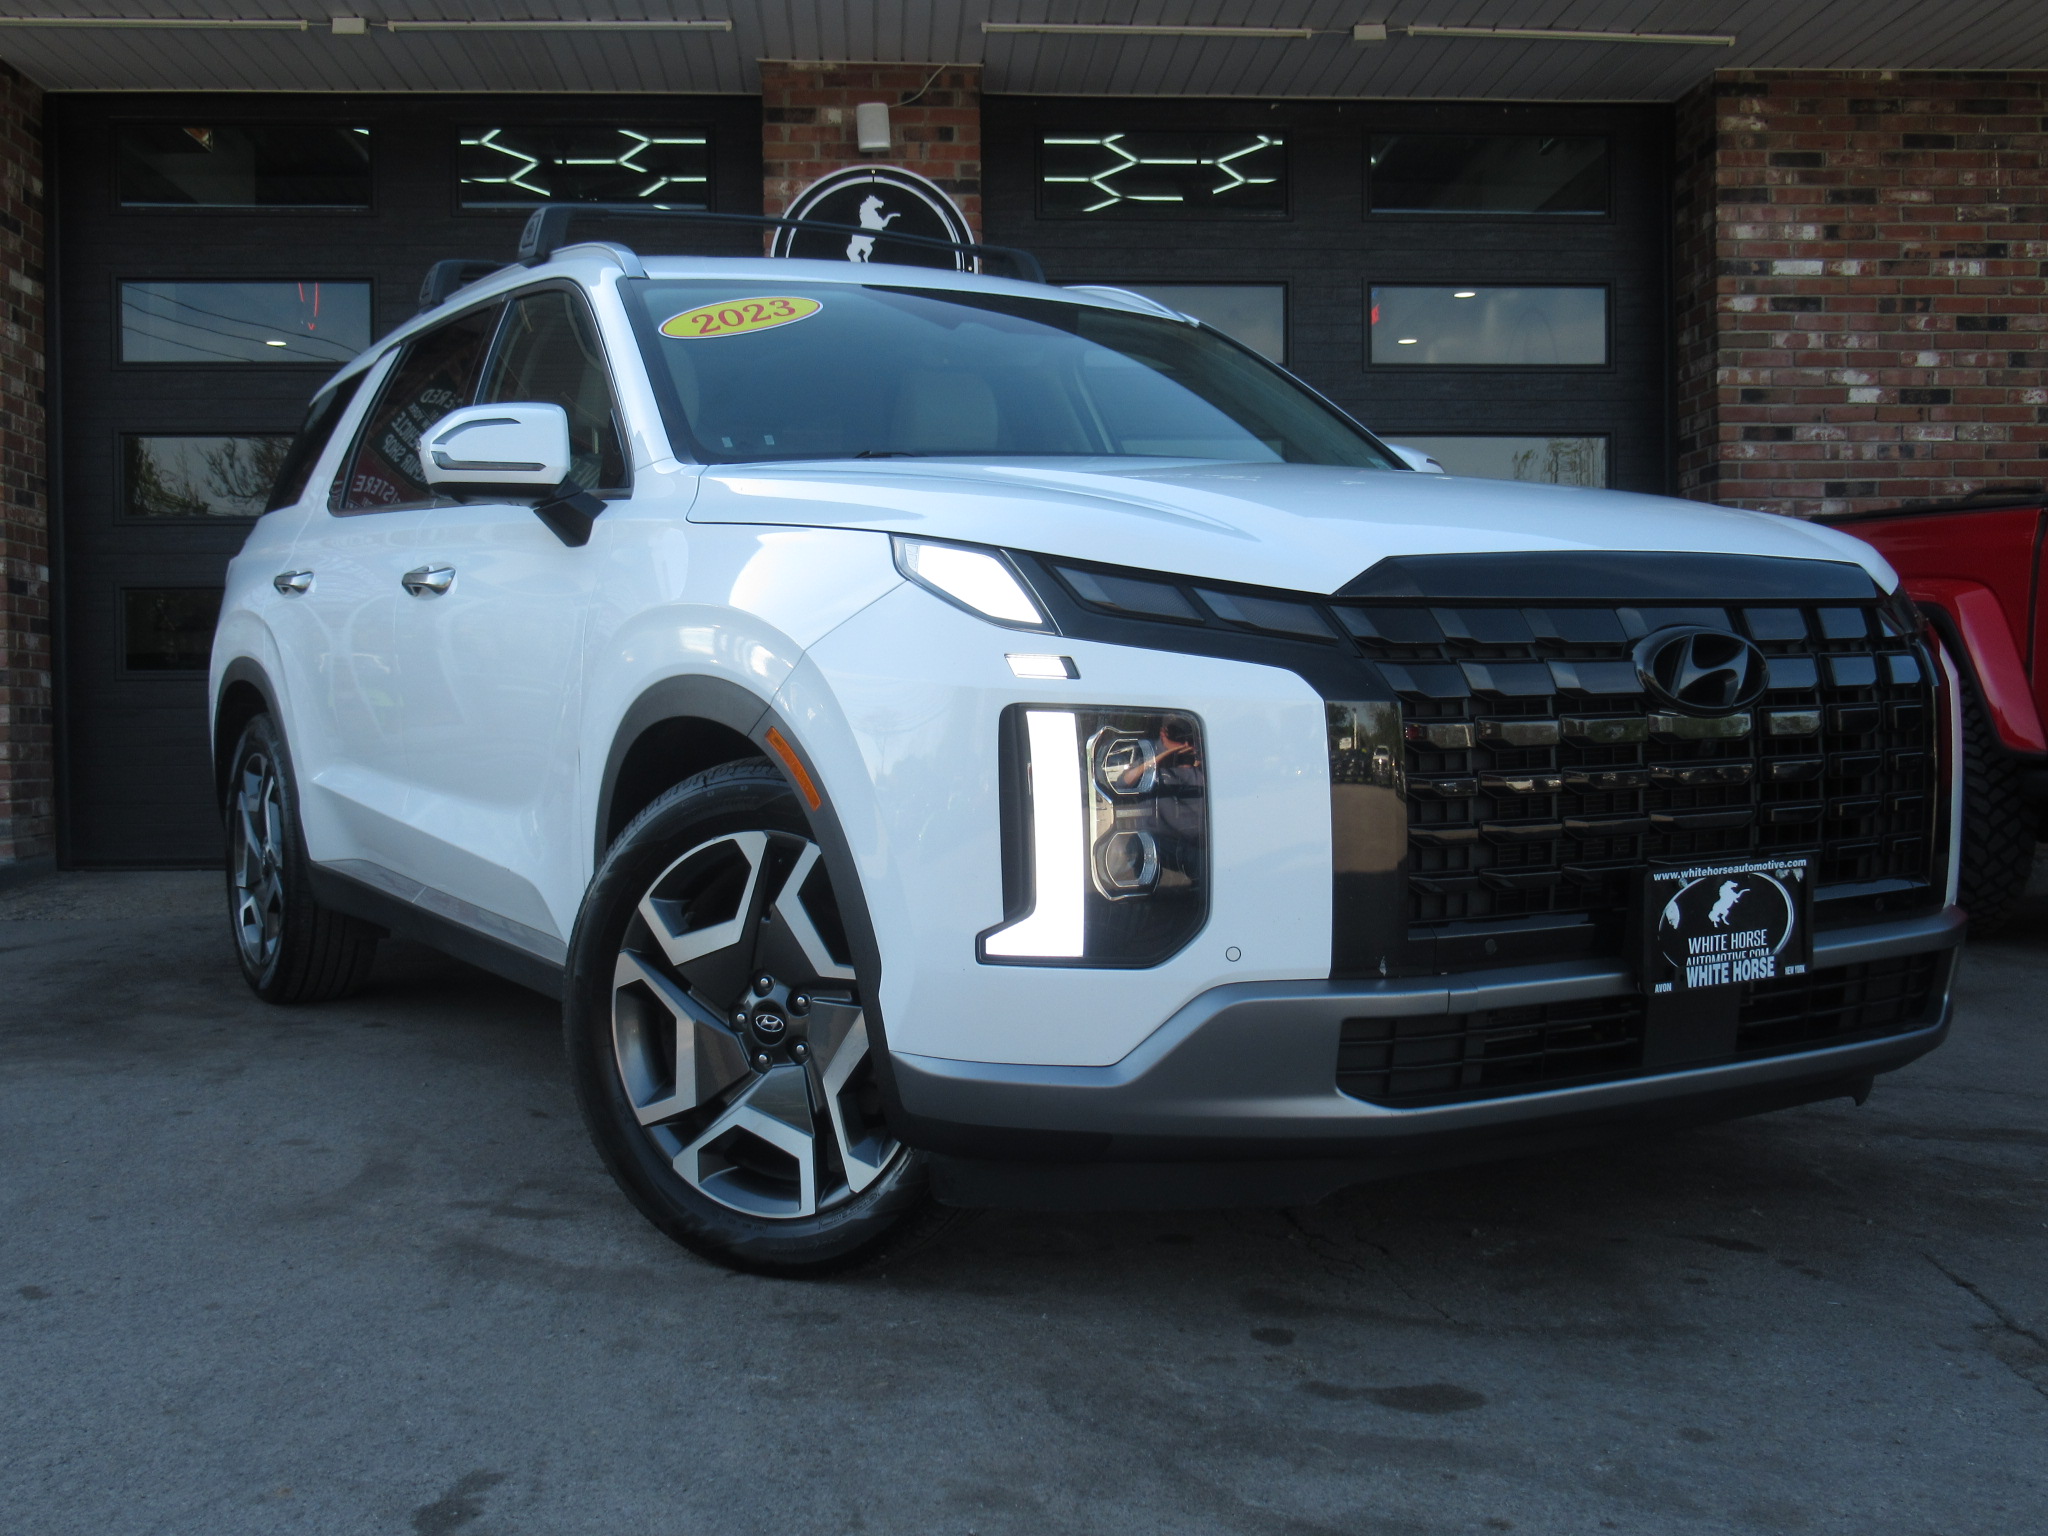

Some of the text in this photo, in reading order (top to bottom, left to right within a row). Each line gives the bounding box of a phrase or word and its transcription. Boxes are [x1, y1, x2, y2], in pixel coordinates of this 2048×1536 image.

[691, 299, 796, 334] 2023
[1653, 859, 1807, 881] www.whitehorseautomotive.com
[1688, 928, 1768, 955] WHITE HORSE
[1686, 955, 1775, 988] WHITE HORSE
[1654, 982, 1673, 994] AVON
